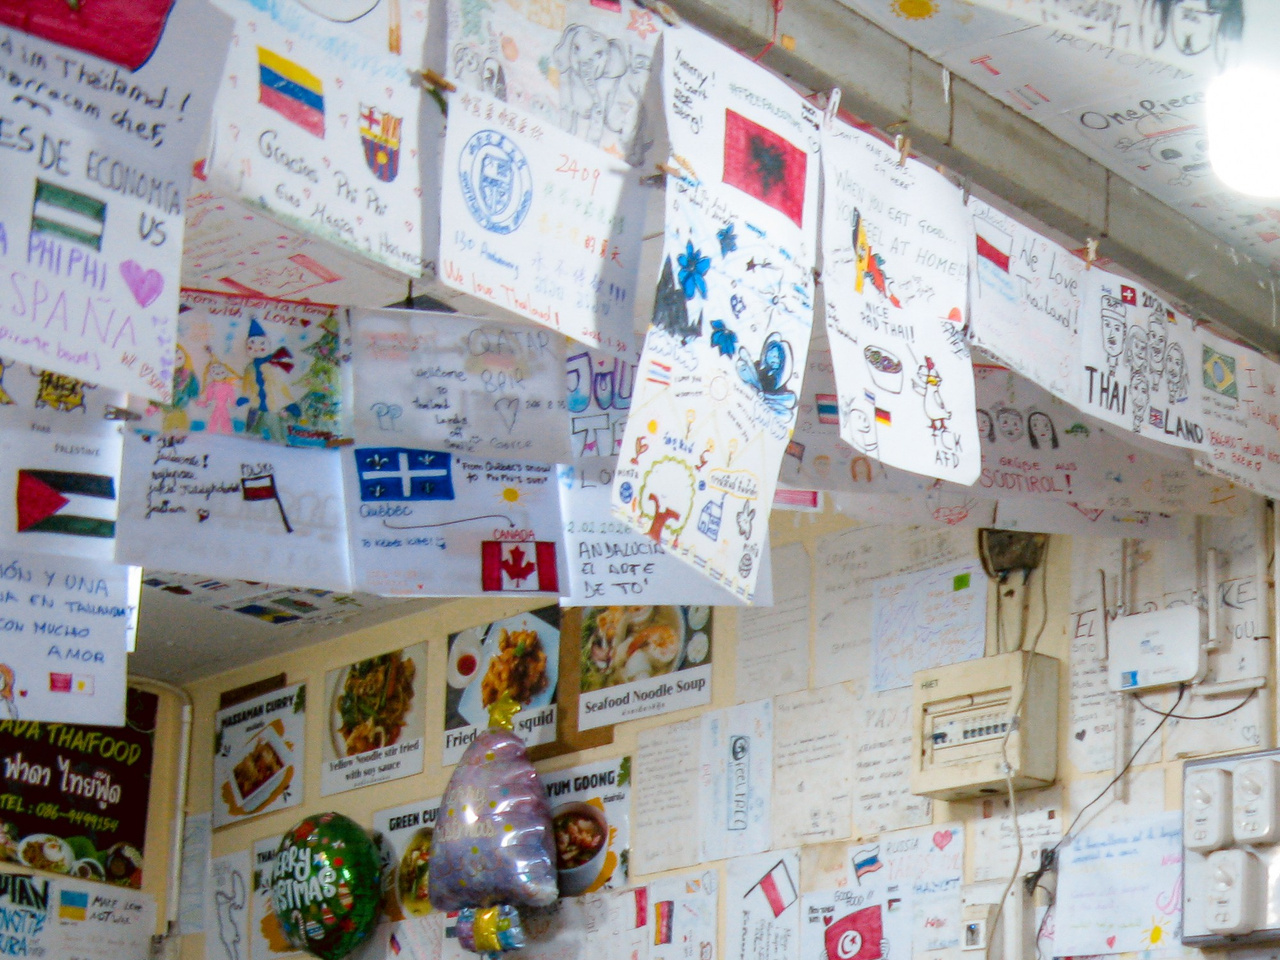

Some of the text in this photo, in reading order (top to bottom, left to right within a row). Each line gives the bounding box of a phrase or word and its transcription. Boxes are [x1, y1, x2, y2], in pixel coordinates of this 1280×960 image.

[39, 133, 70, 176] DE
[139, 211, 166, 246] US
[887, 206, 912, 228] EAT
[890, 239, 911, 256] AT
[444, 260, 465, 286] We
[1020, 237, 1079, 297] We Love
[864, 301, 890, 320] NICE
[1085, 365, 1128, 416] THAI
[1163, 406, 1205, 444] LAND
[492, 528, 536, 541] CANADA
[65, 574, 110, 598] UNA
[47, 645, 105, 663] AMOR
[585, 675, 707, 714] Seafood Noodle Soup
[221, 694, 295, 729] MASSAMAN CURRY
[446, 709, 554, 749] Fried squid
[48, 723, 142, 767] THAIFOOD
[328, 757, 354, 773] Yellow
[378, 759, 402, 773] sauce
[547, 769, 616, 797] YUM GOONG
[389, 813, 421, 832] GREEN
